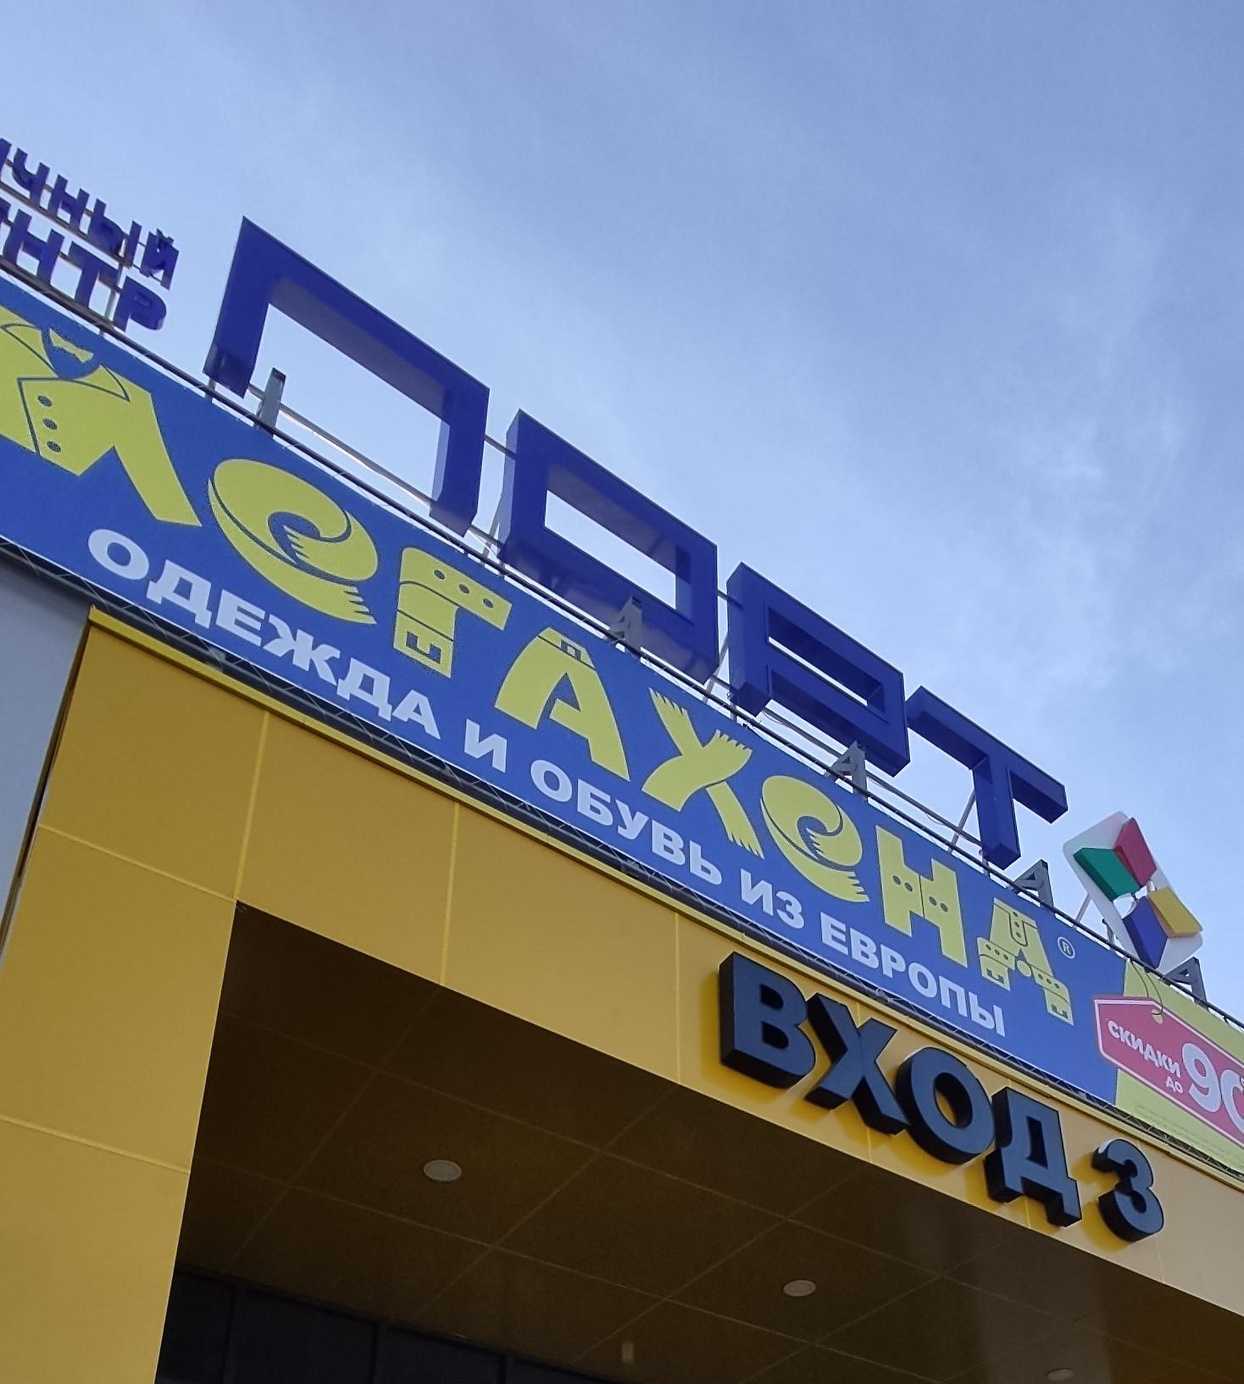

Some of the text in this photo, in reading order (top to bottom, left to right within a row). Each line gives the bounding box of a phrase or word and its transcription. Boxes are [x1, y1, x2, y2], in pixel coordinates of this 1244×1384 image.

[0, 199, 167, 333] НТР
[203, 216, 1068, 870] ПОРТ
[87, 528, 1006, 1037] ОДЕЖДА И ОБУВЬ ИЗ ЕВРОПЫ
[719, 951, 1164, 1242] ВХОД 3
[1107, 1020, 1182, 1078] СКИДКИ
[1165, 1076, 1184, 1095] ДО
